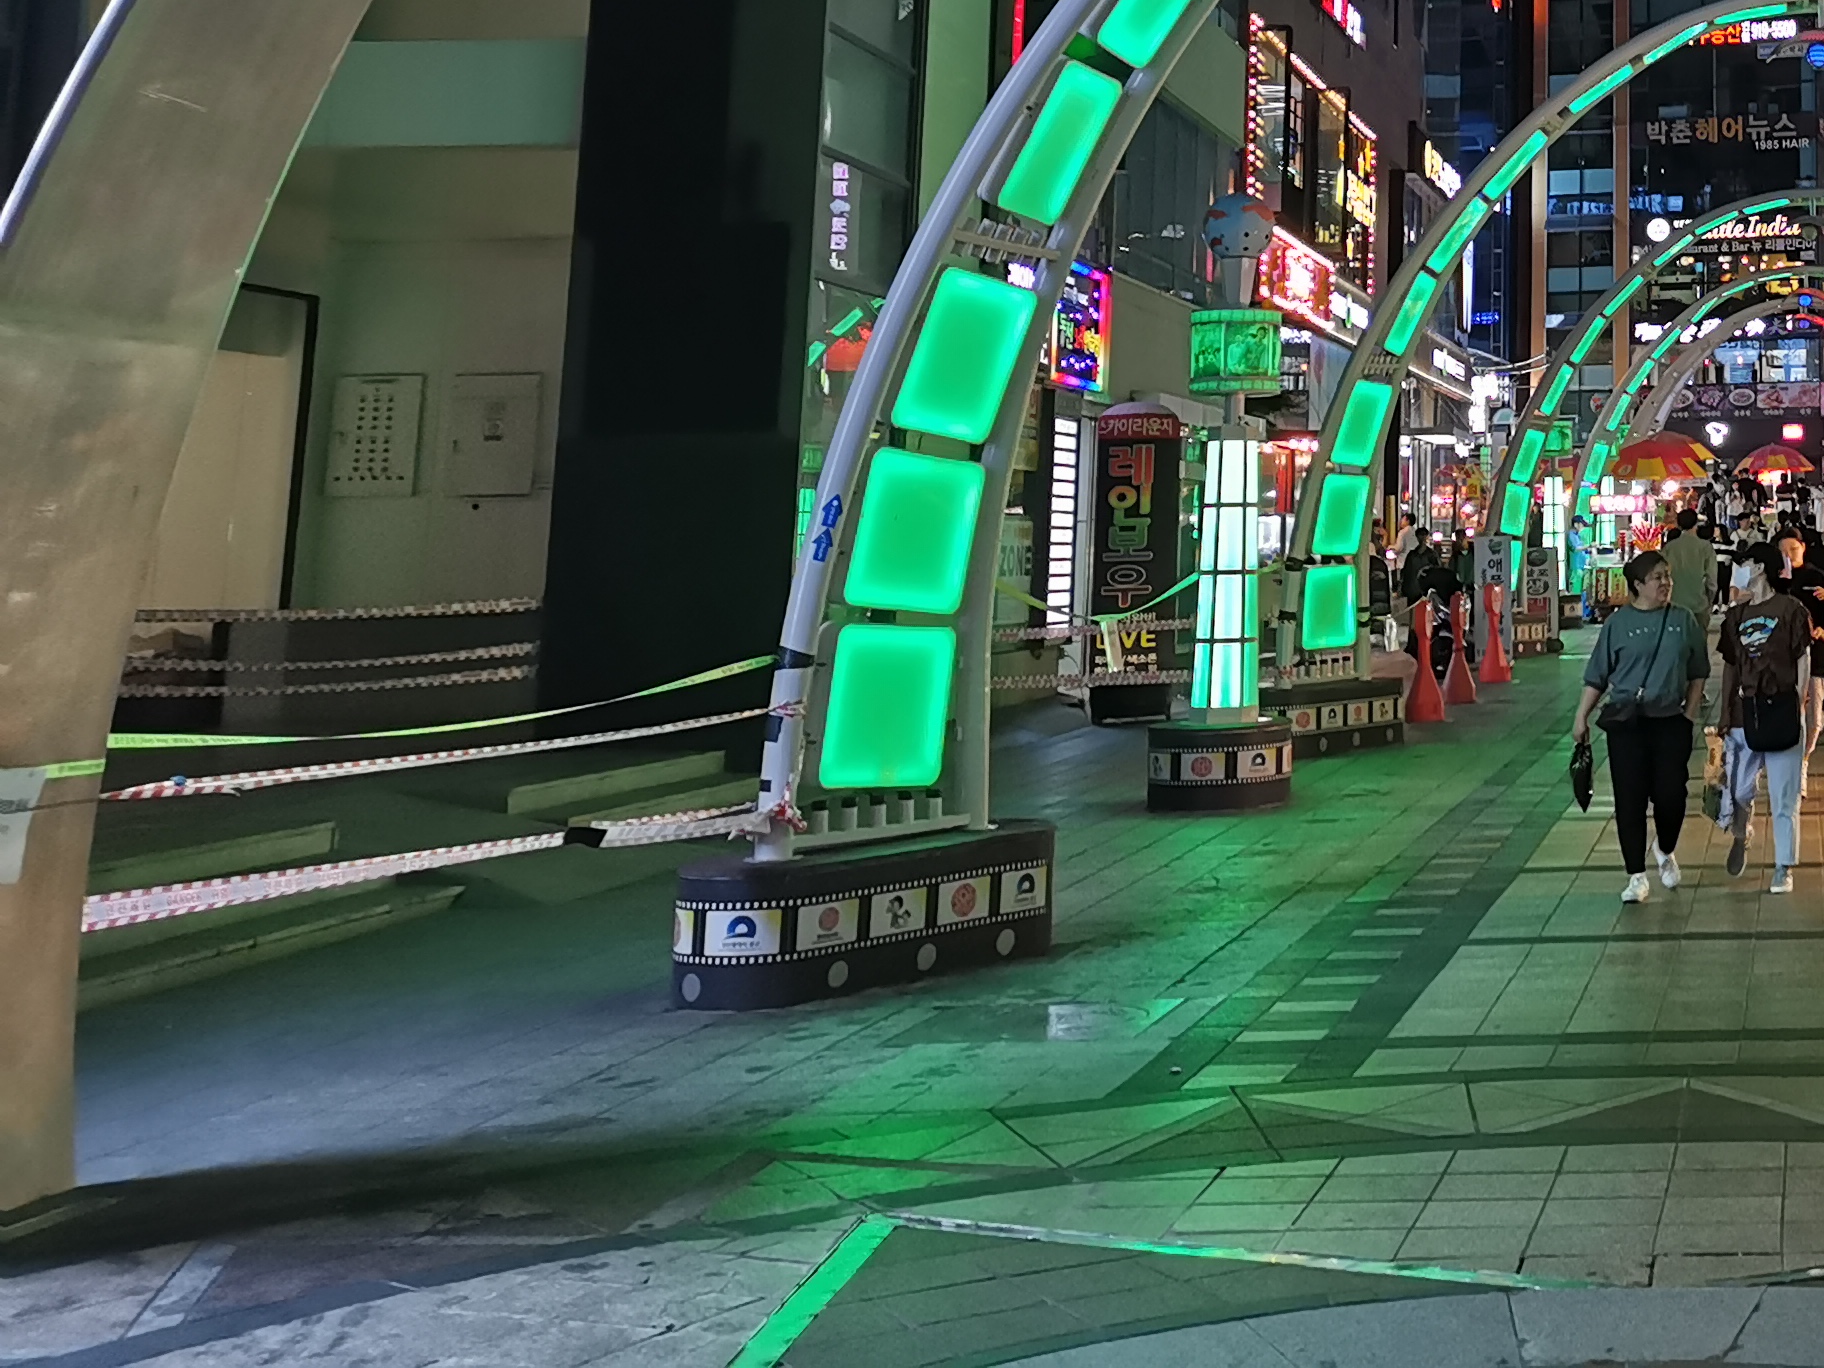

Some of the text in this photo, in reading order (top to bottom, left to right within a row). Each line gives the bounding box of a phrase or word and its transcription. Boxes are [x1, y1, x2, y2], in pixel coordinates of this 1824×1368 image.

[1755, 138, 1810, 151] 1985 HAIR
[1732, 241, 1750, 252] Bar
[1101, 444, 1155, 608] 레인보우
[1096, 632, 1157, 649] LVE
